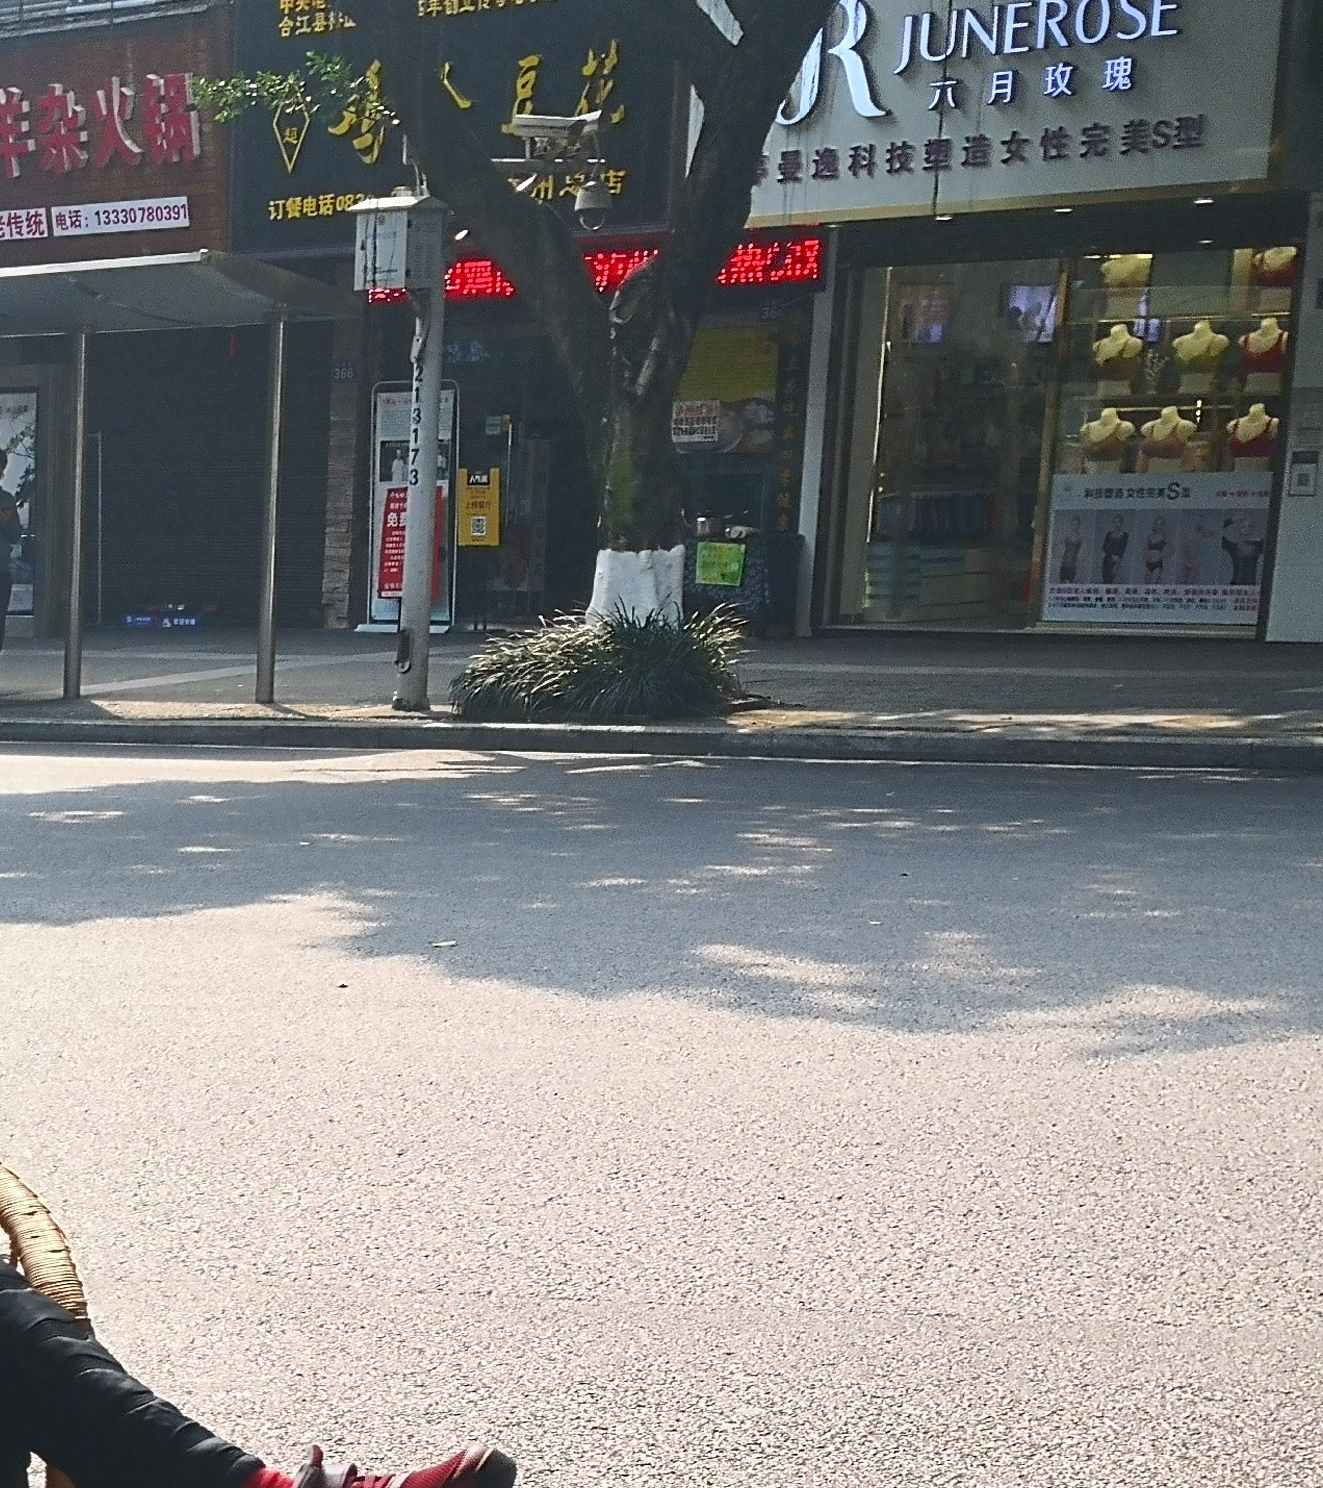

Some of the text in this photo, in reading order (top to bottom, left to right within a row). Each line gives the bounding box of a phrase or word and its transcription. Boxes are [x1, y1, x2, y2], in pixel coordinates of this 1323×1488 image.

[893, 0, 1179, 76] JUNEROSE
[927, 56, 1133, 111] 六月玫瑰
